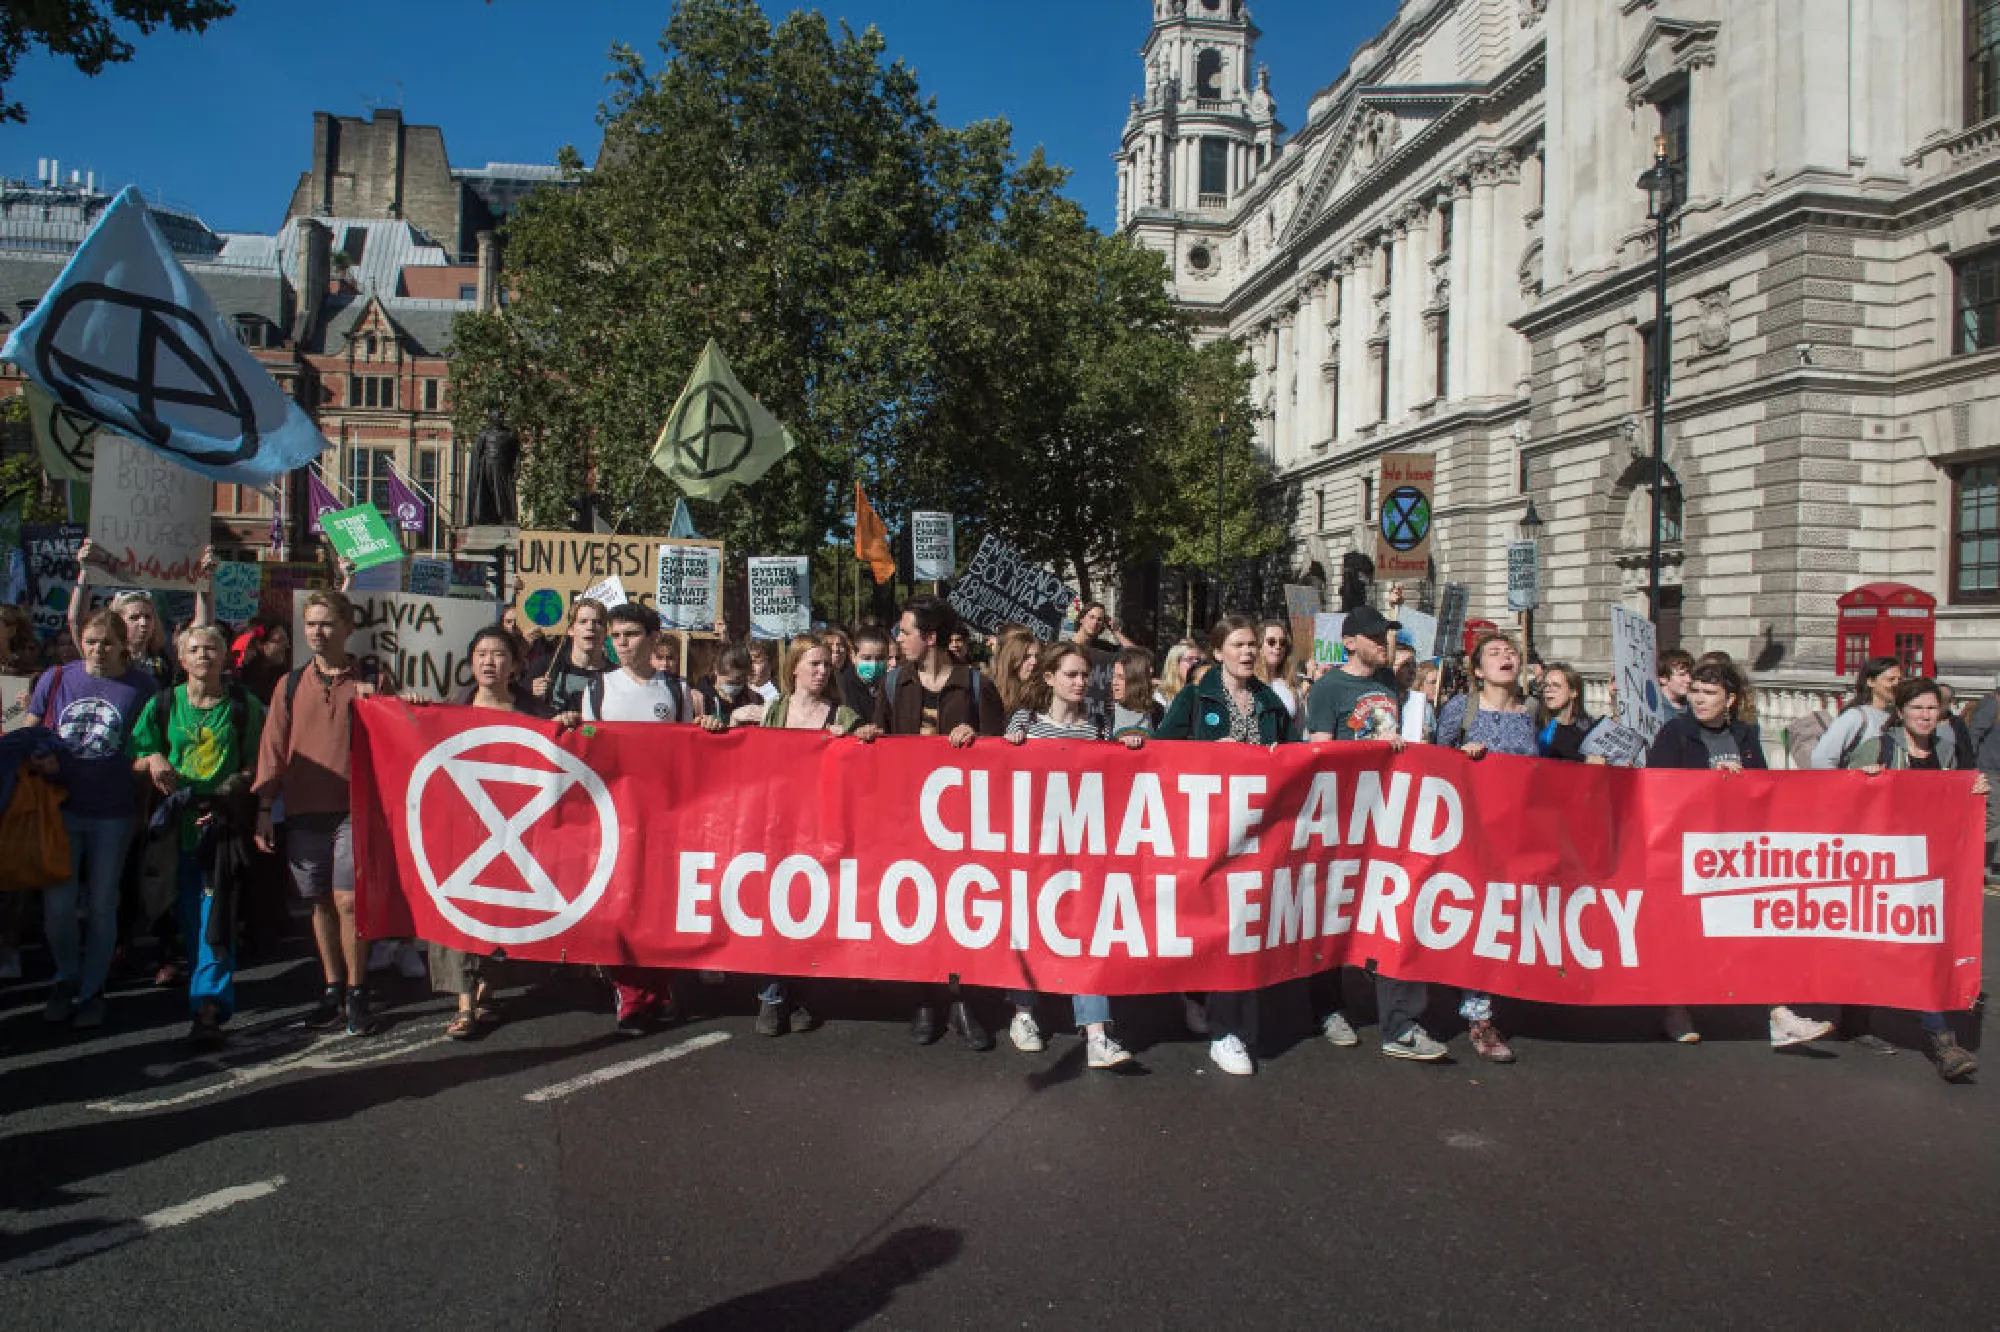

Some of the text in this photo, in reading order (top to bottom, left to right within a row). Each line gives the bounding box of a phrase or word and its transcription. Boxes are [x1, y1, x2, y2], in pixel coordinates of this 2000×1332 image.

[1406, 462, 1433, 480] have
[131, 494, 171, 518] OUR
[661, 556, 708, 567] SYSTEM
[661, 566, 708, 578] CHANGE
[751, 567, 798, 577] SYSTEM
[661, 575, 683, 586] NOT
[751, 577, 799, 587] CHANGE
[660, 586, 708, 597] CLIMATE
[751, 587, 774, 597] NOT
[659, 595, 708, 605] CHANGE
[751, 596, 802, 606] CLIMATE
[752, 605, 800, 615] CHANGE
[371, 630, 399, 653] IS
[920, 766, 1464, 858] CLIMATE AND
[1693, 835, 1896, 880] extinction
[675, 850, 1644, 970] ECOLOGICAL EMERGENCY
[1753, 883, 1938, 937] rebellion
